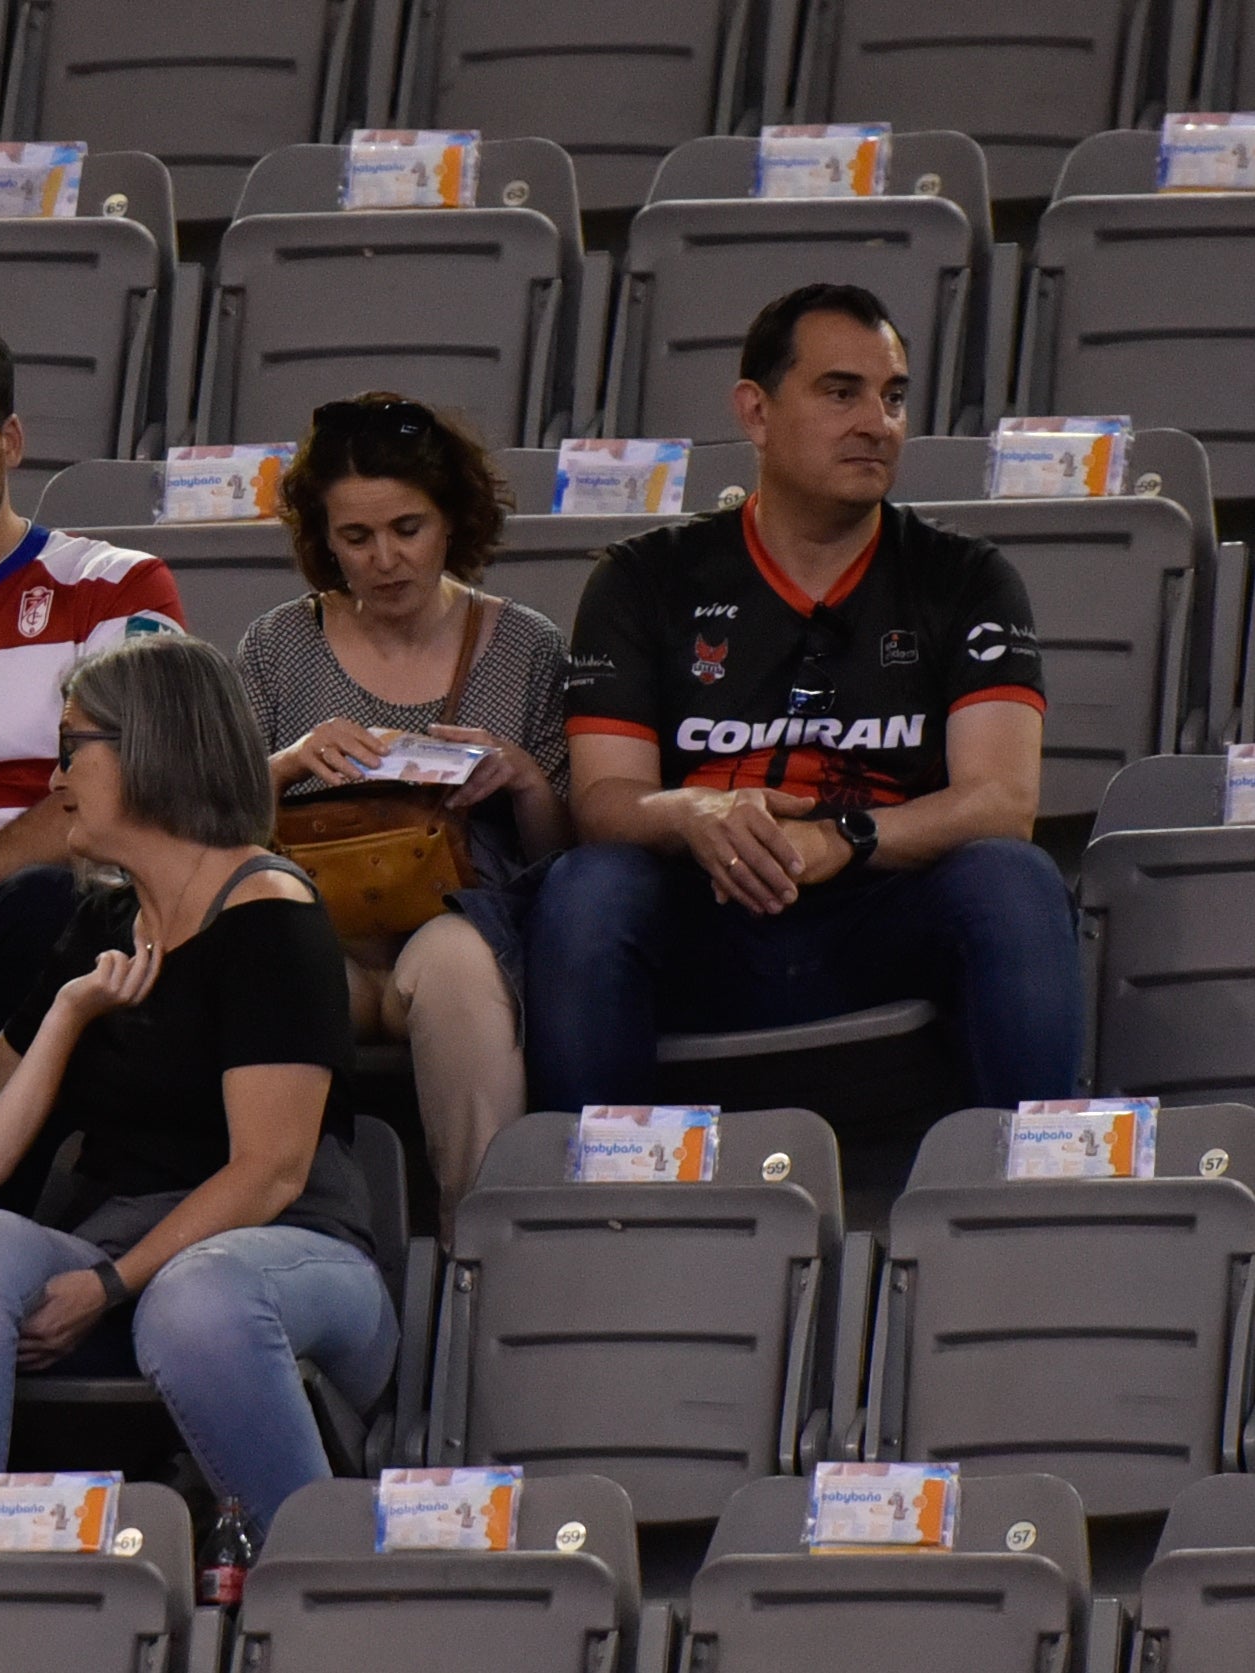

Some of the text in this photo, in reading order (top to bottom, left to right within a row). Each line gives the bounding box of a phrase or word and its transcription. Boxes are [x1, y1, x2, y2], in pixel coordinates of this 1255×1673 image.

[506, 187, 524, 200] 63
[724, 494, 739, 505] 61
[694, 603, 739, 619] vive
[676, 714, 926, 753] COVIRAN
[583, 1143, 643, 1156] babybaño
[766, 1161, 785, 1175] 59
[1205, 1157, 1223, 1171] 57
[121, 1538, 136, 1549] 61
[1013, 1530, 1031, 1544] 57
